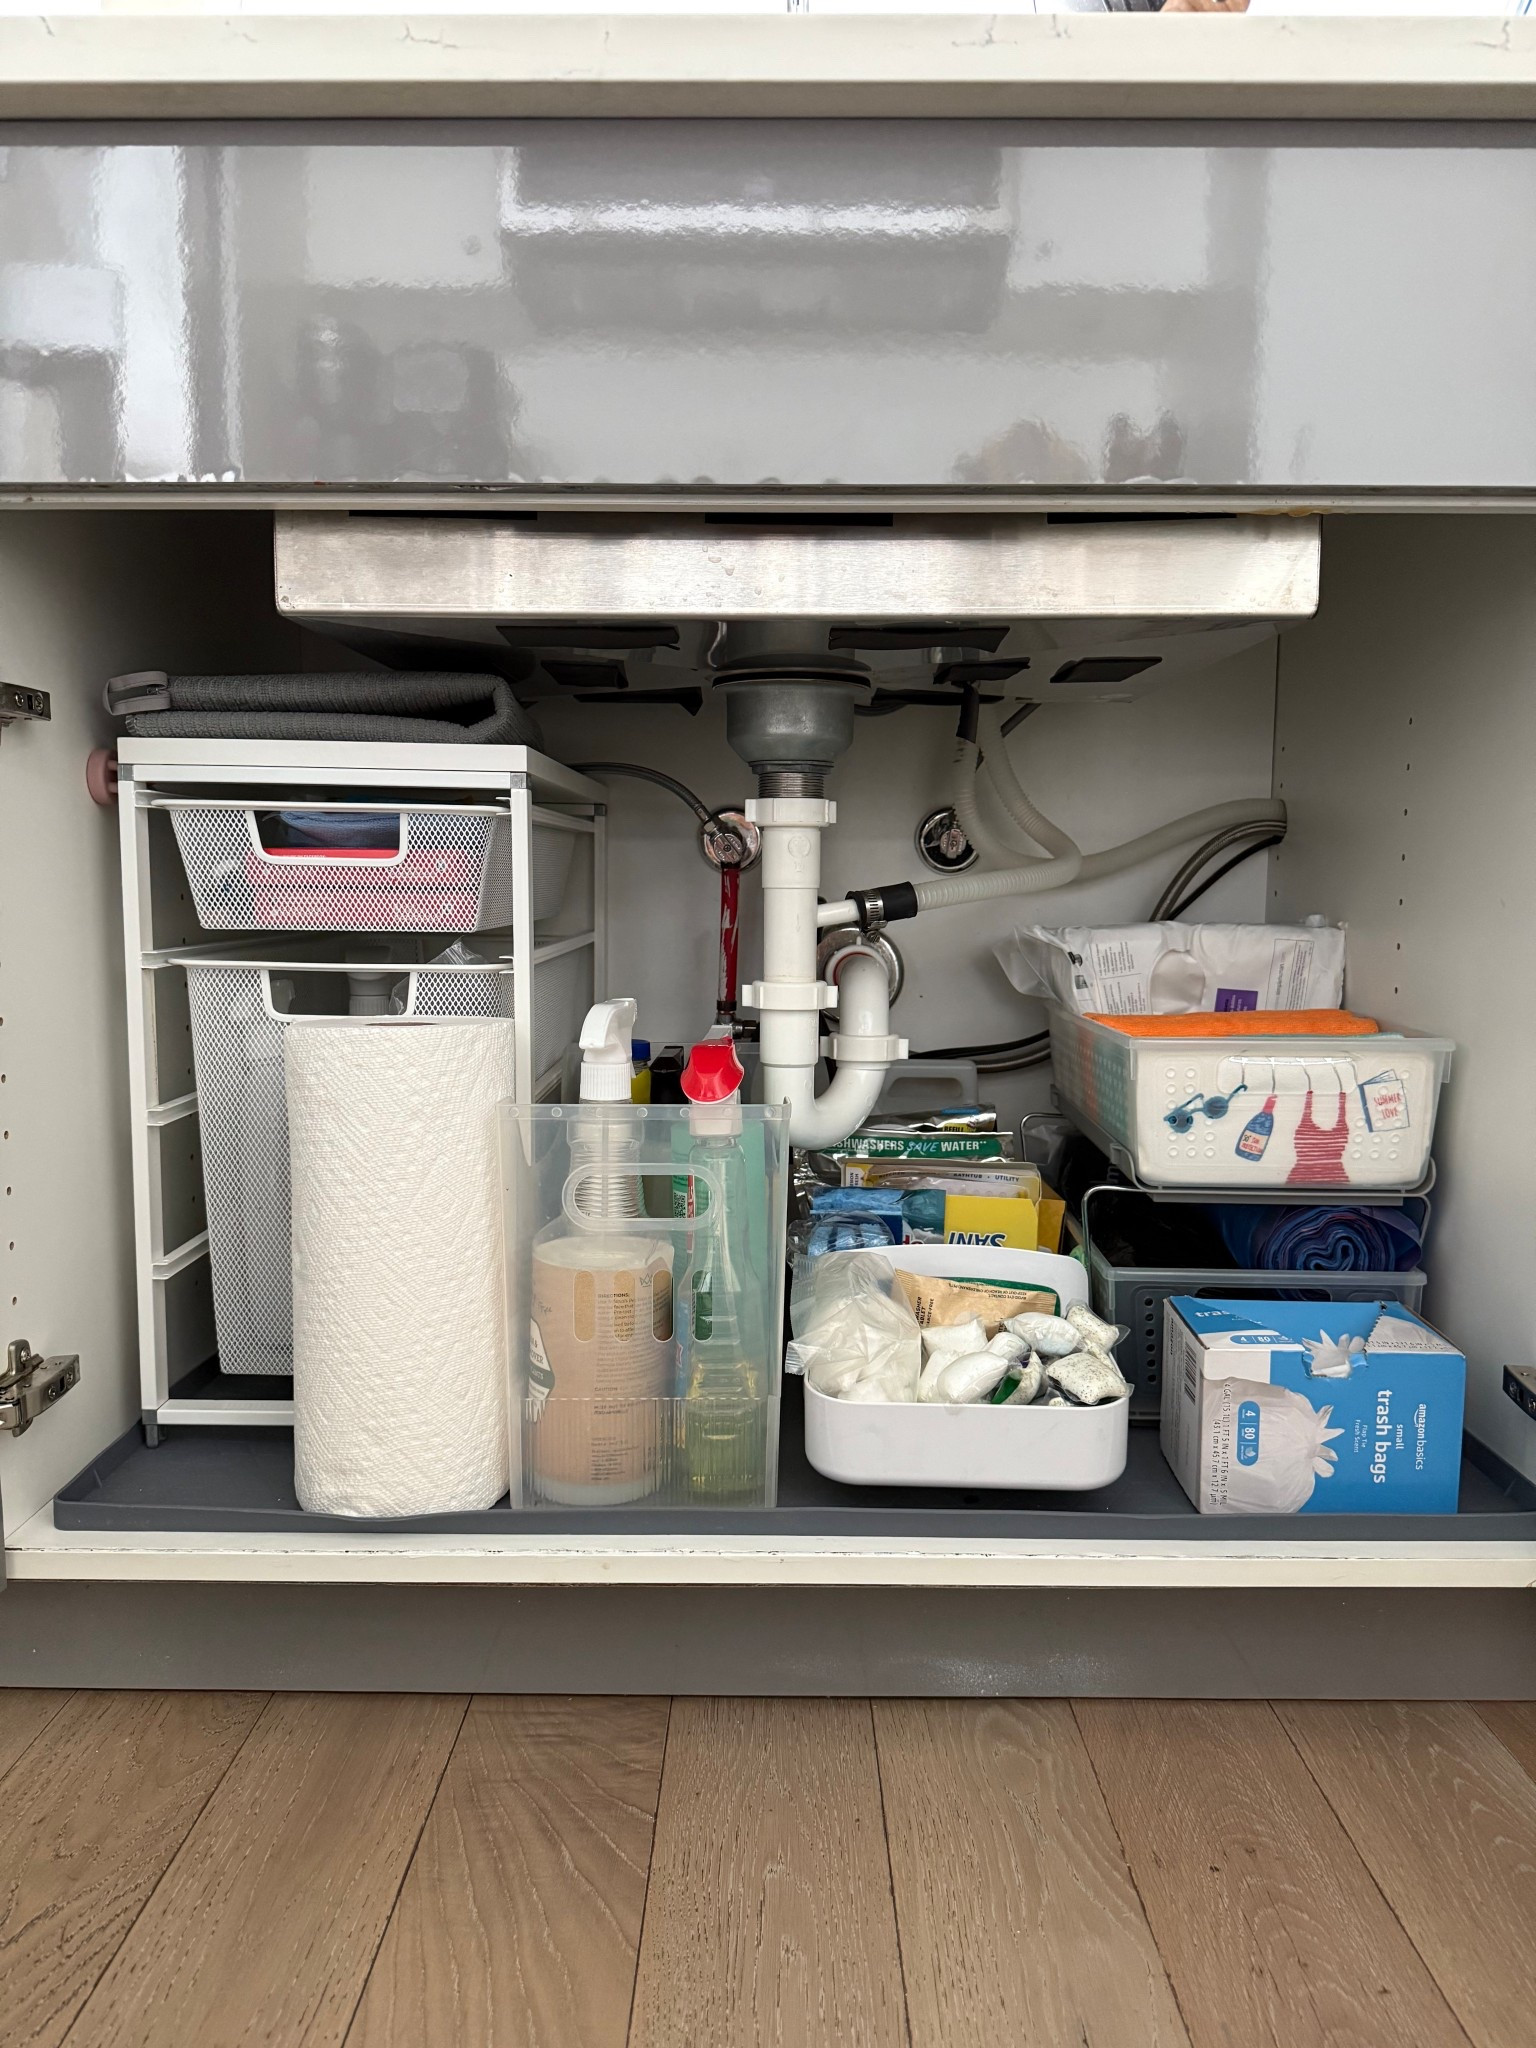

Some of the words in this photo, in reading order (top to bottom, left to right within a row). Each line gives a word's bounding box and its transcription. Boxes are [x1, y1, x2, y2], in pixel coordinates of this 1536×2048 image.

[1382, 1107, 1398, 1119] LOVE
[907, 1141, 939, 1154] SAVE
[1376, 1390, 1392, 1436] trash
[1213, 1436, 1218, 1444] cm
[1244, 1427, 1256, 1440] 80
[1396, 1424, 1404, 1450] small
[1212, 1465, 1217, 1473] cm
[1370, 1442, 1392, 1484] bags
